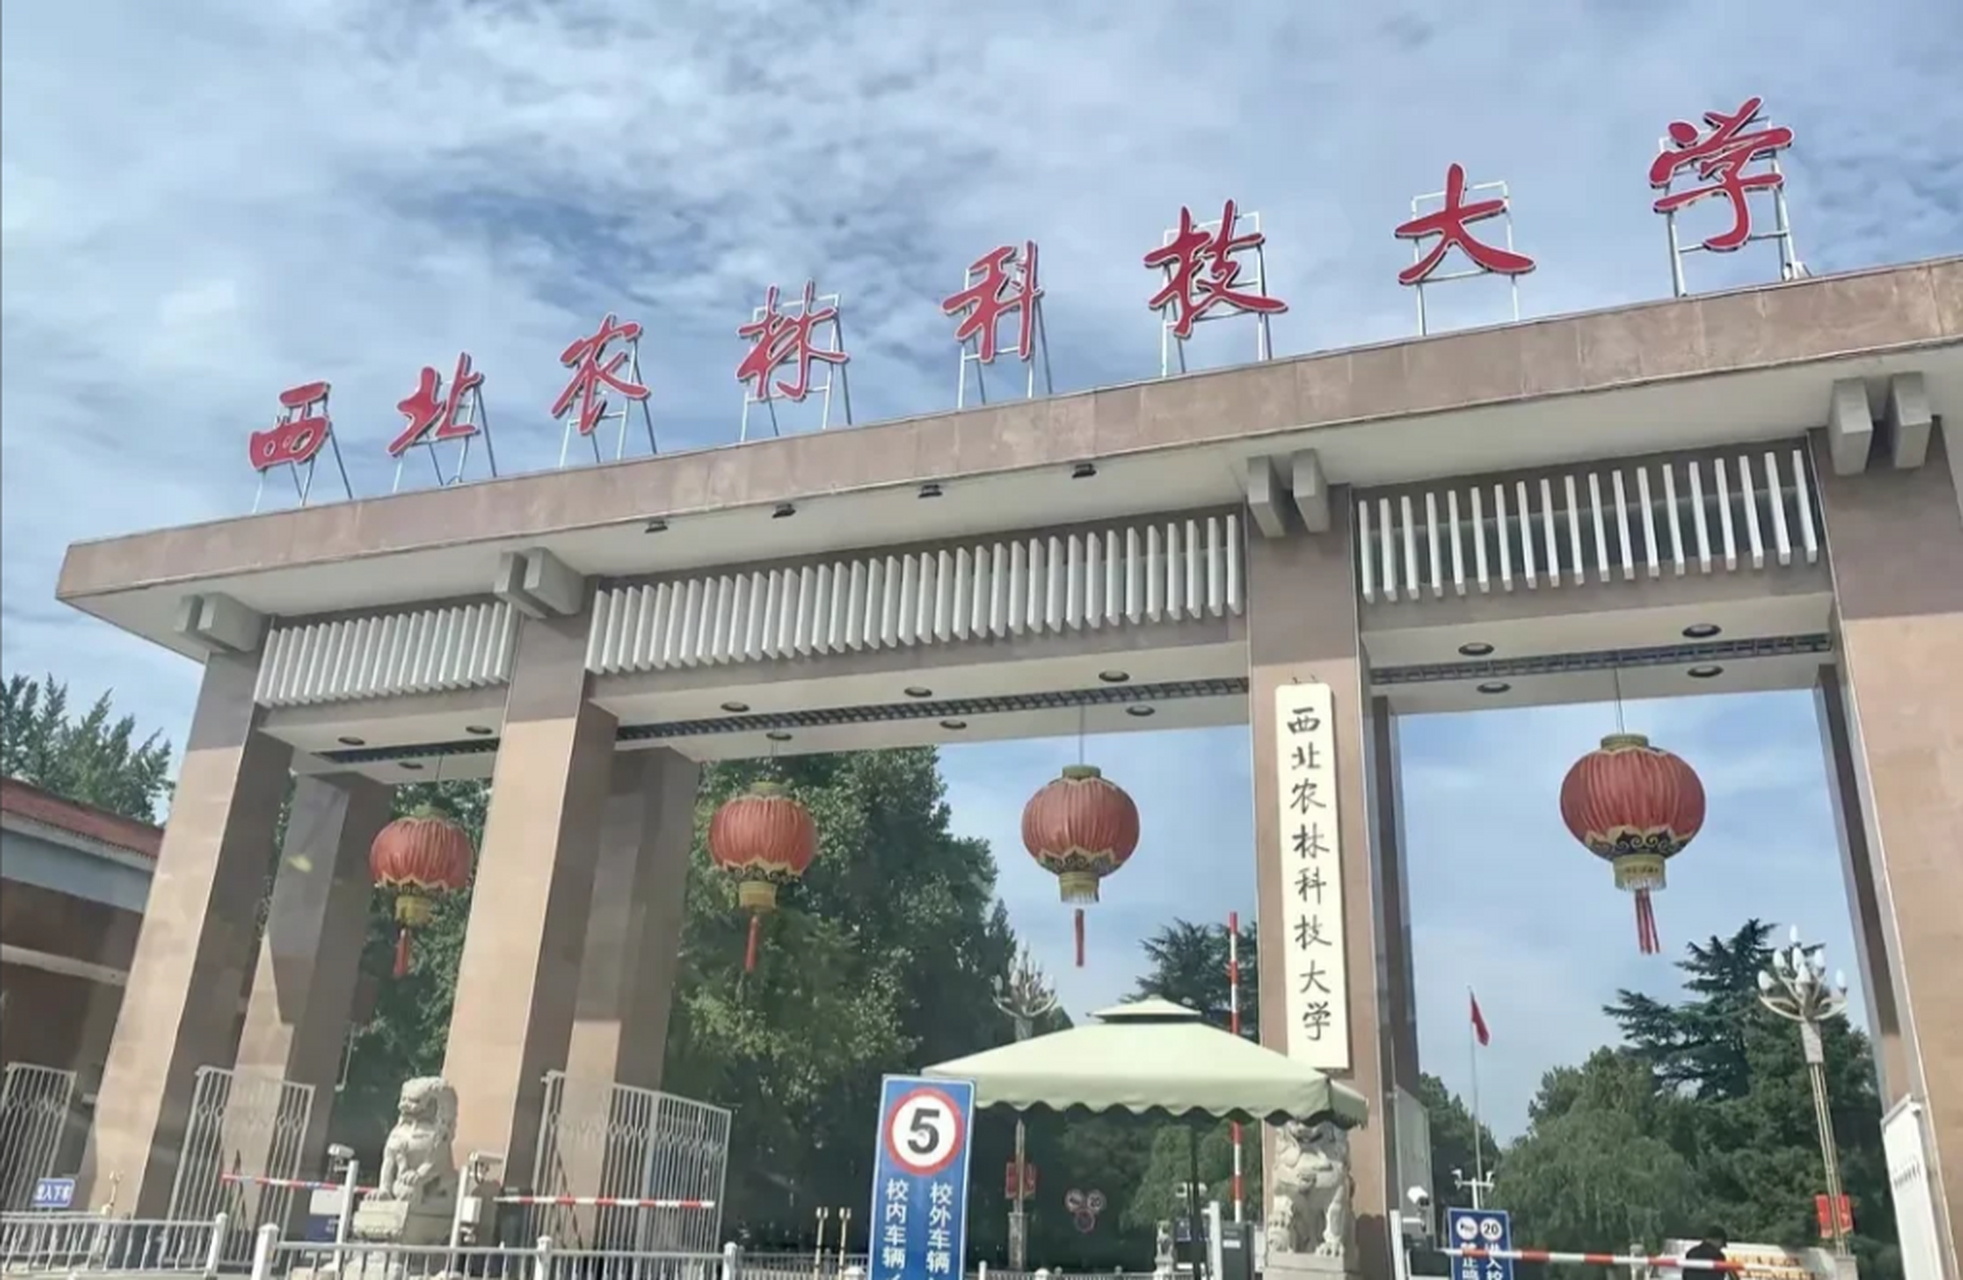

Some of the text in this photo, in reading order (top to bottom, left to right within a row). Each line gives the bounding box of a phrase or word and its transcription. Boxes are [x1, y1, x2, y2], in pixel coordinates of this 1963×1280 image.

[249, 96, 1794, 472] 西北农林科技大学
[1286, 706, 1333, 1042] 西北农林科技大学
[907, 1107, 940, 1155] 5
[882, 1178, 909, 1280] 校内车辆
[926, 1182, 953, 1280] 校外车辆
[1483, 1222, 1499, 1236] 20
